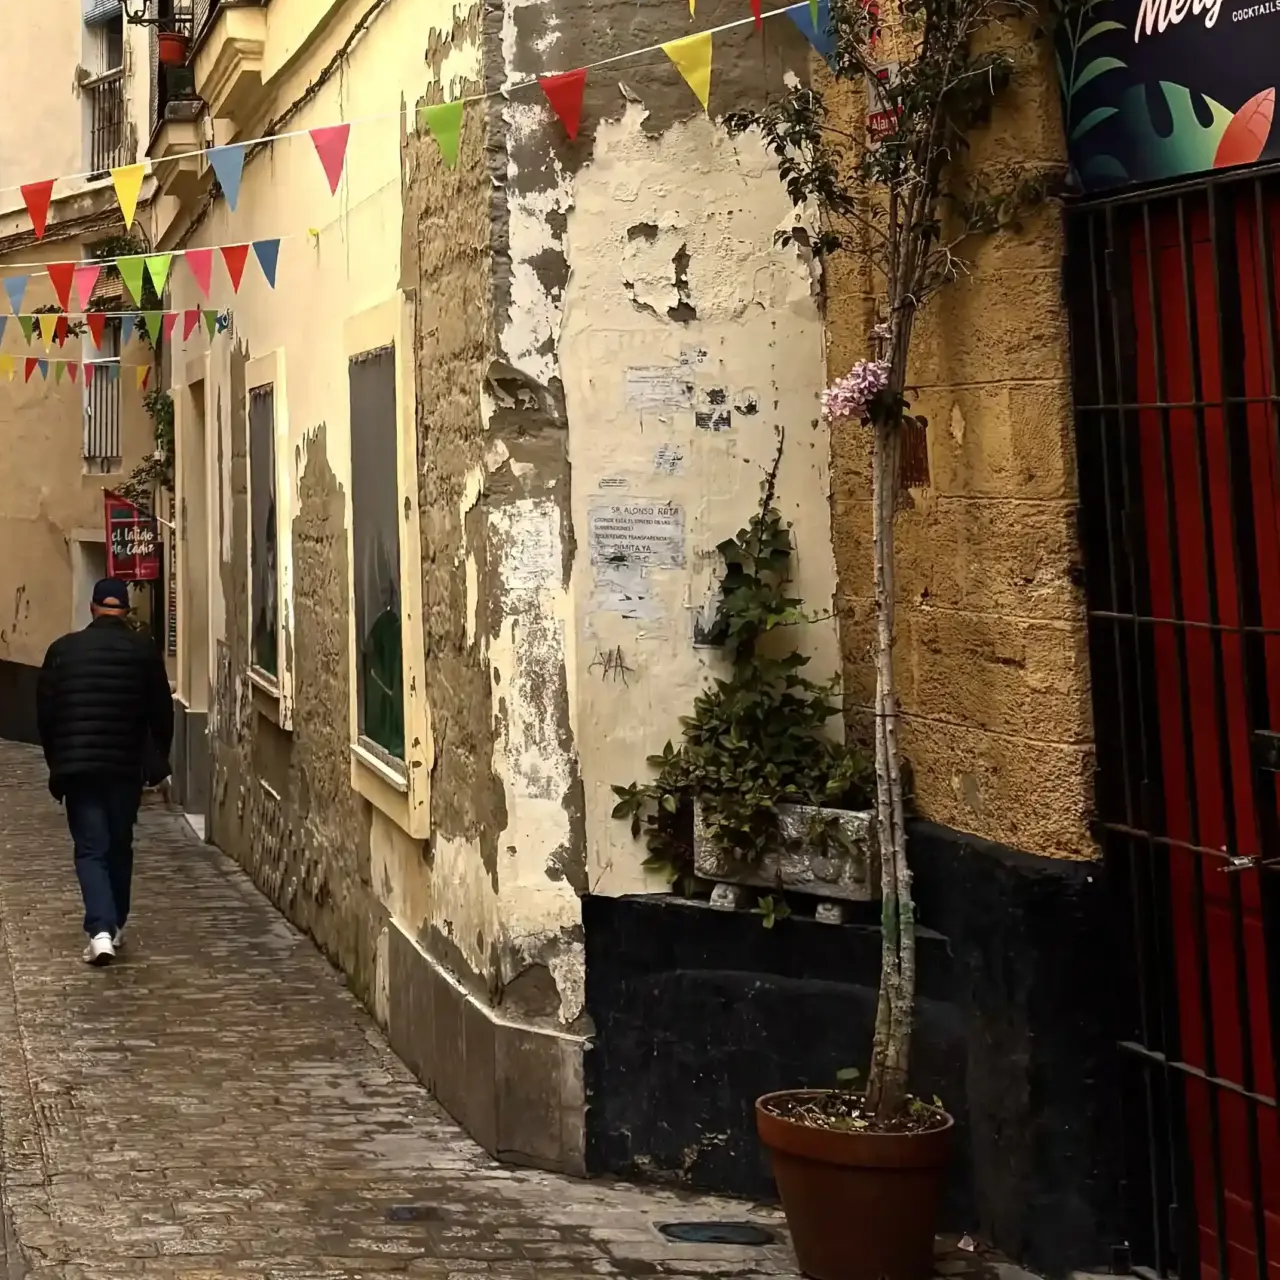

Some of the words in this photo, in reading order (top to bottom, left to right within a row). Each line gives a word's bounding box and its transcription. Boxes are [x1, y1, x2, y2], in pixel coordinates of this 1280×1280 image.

[624, 506, 654, 516] ALONSO
[111, 528, 122, 541] el
[124, 526, 154, 541] latido
[111, 542, 124, 555] de
